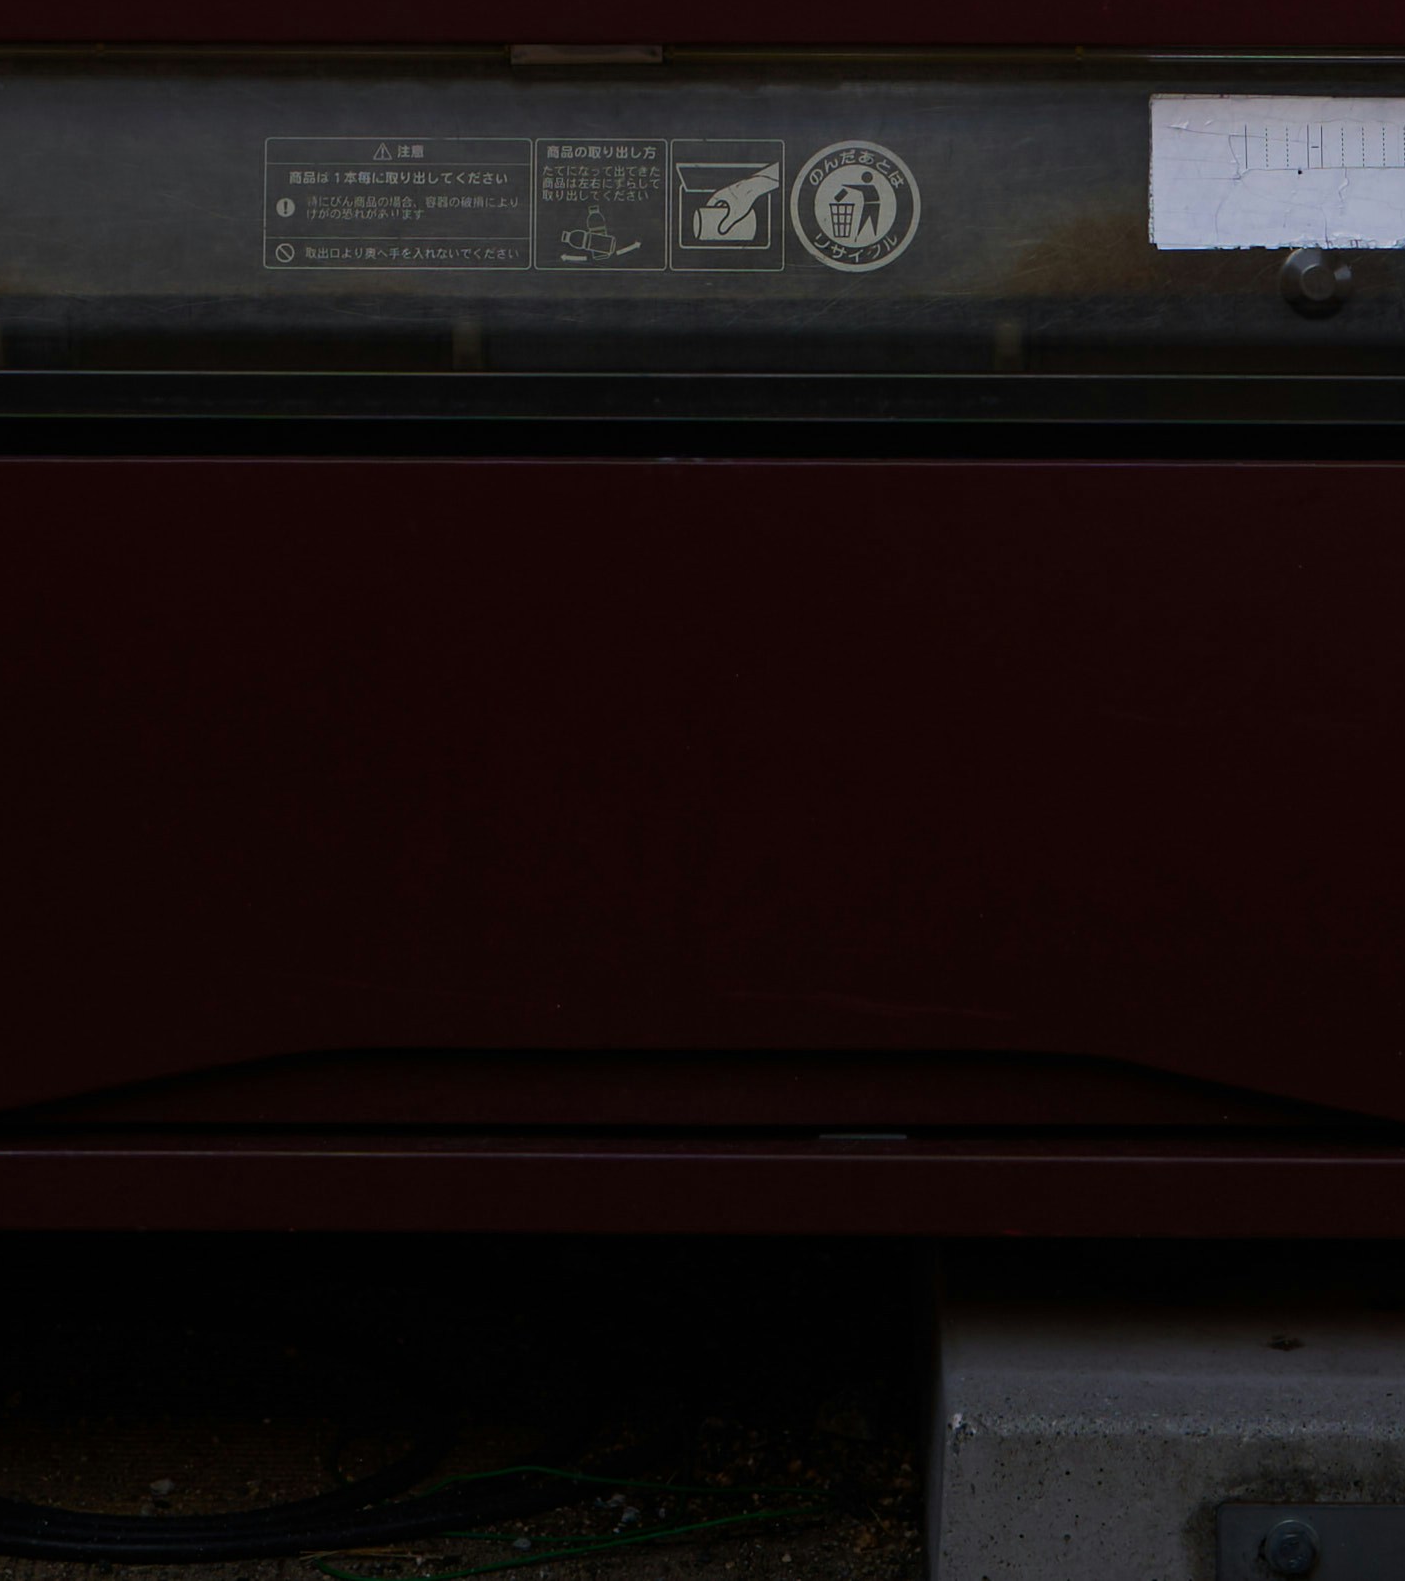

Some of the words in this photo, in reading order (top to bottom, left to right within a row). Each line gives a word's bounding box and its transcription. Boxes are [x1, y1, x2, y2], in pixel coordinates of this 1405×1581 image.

[547, 146, 657, 159] 商品の取り出し方
[289, 171, 507, 186] 商品は1本毎に取り出してください
